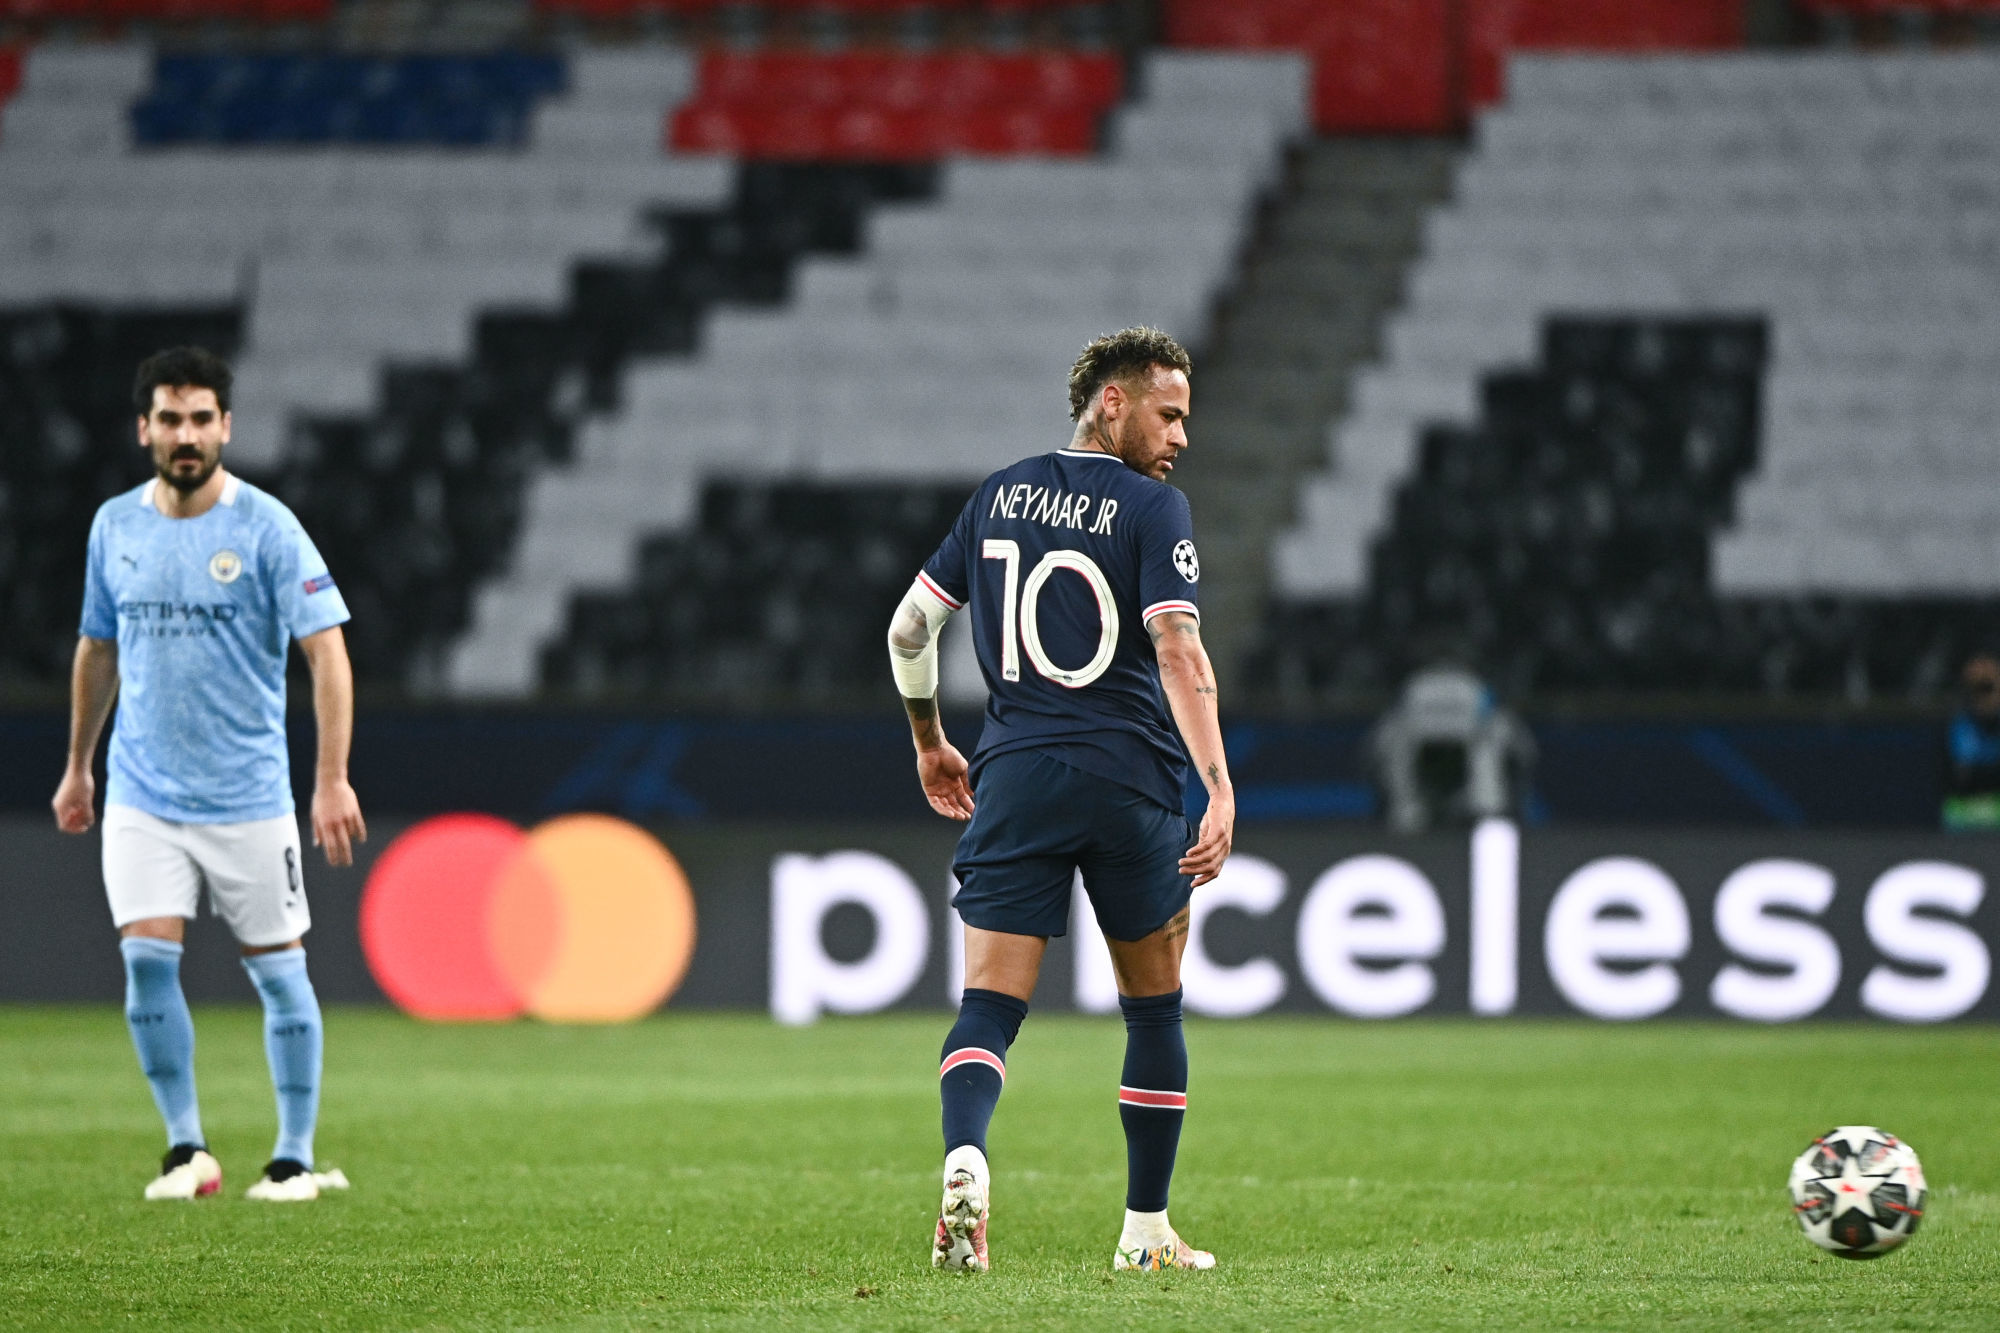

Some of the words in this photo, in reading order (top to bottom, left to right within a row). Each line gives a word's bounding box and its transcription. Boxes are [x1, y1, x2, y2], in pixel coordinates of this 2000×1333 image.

[990, 484, 1090, 530] NEYMAR
[1089, 498, 1118, 535] JR
[119, 601, 237, 622] ETIHAD
[139, 625, 218, 638] IRWAYS
[982, 538, 1119, 688] 10
[769, 816, 1991, 1026] piceless
